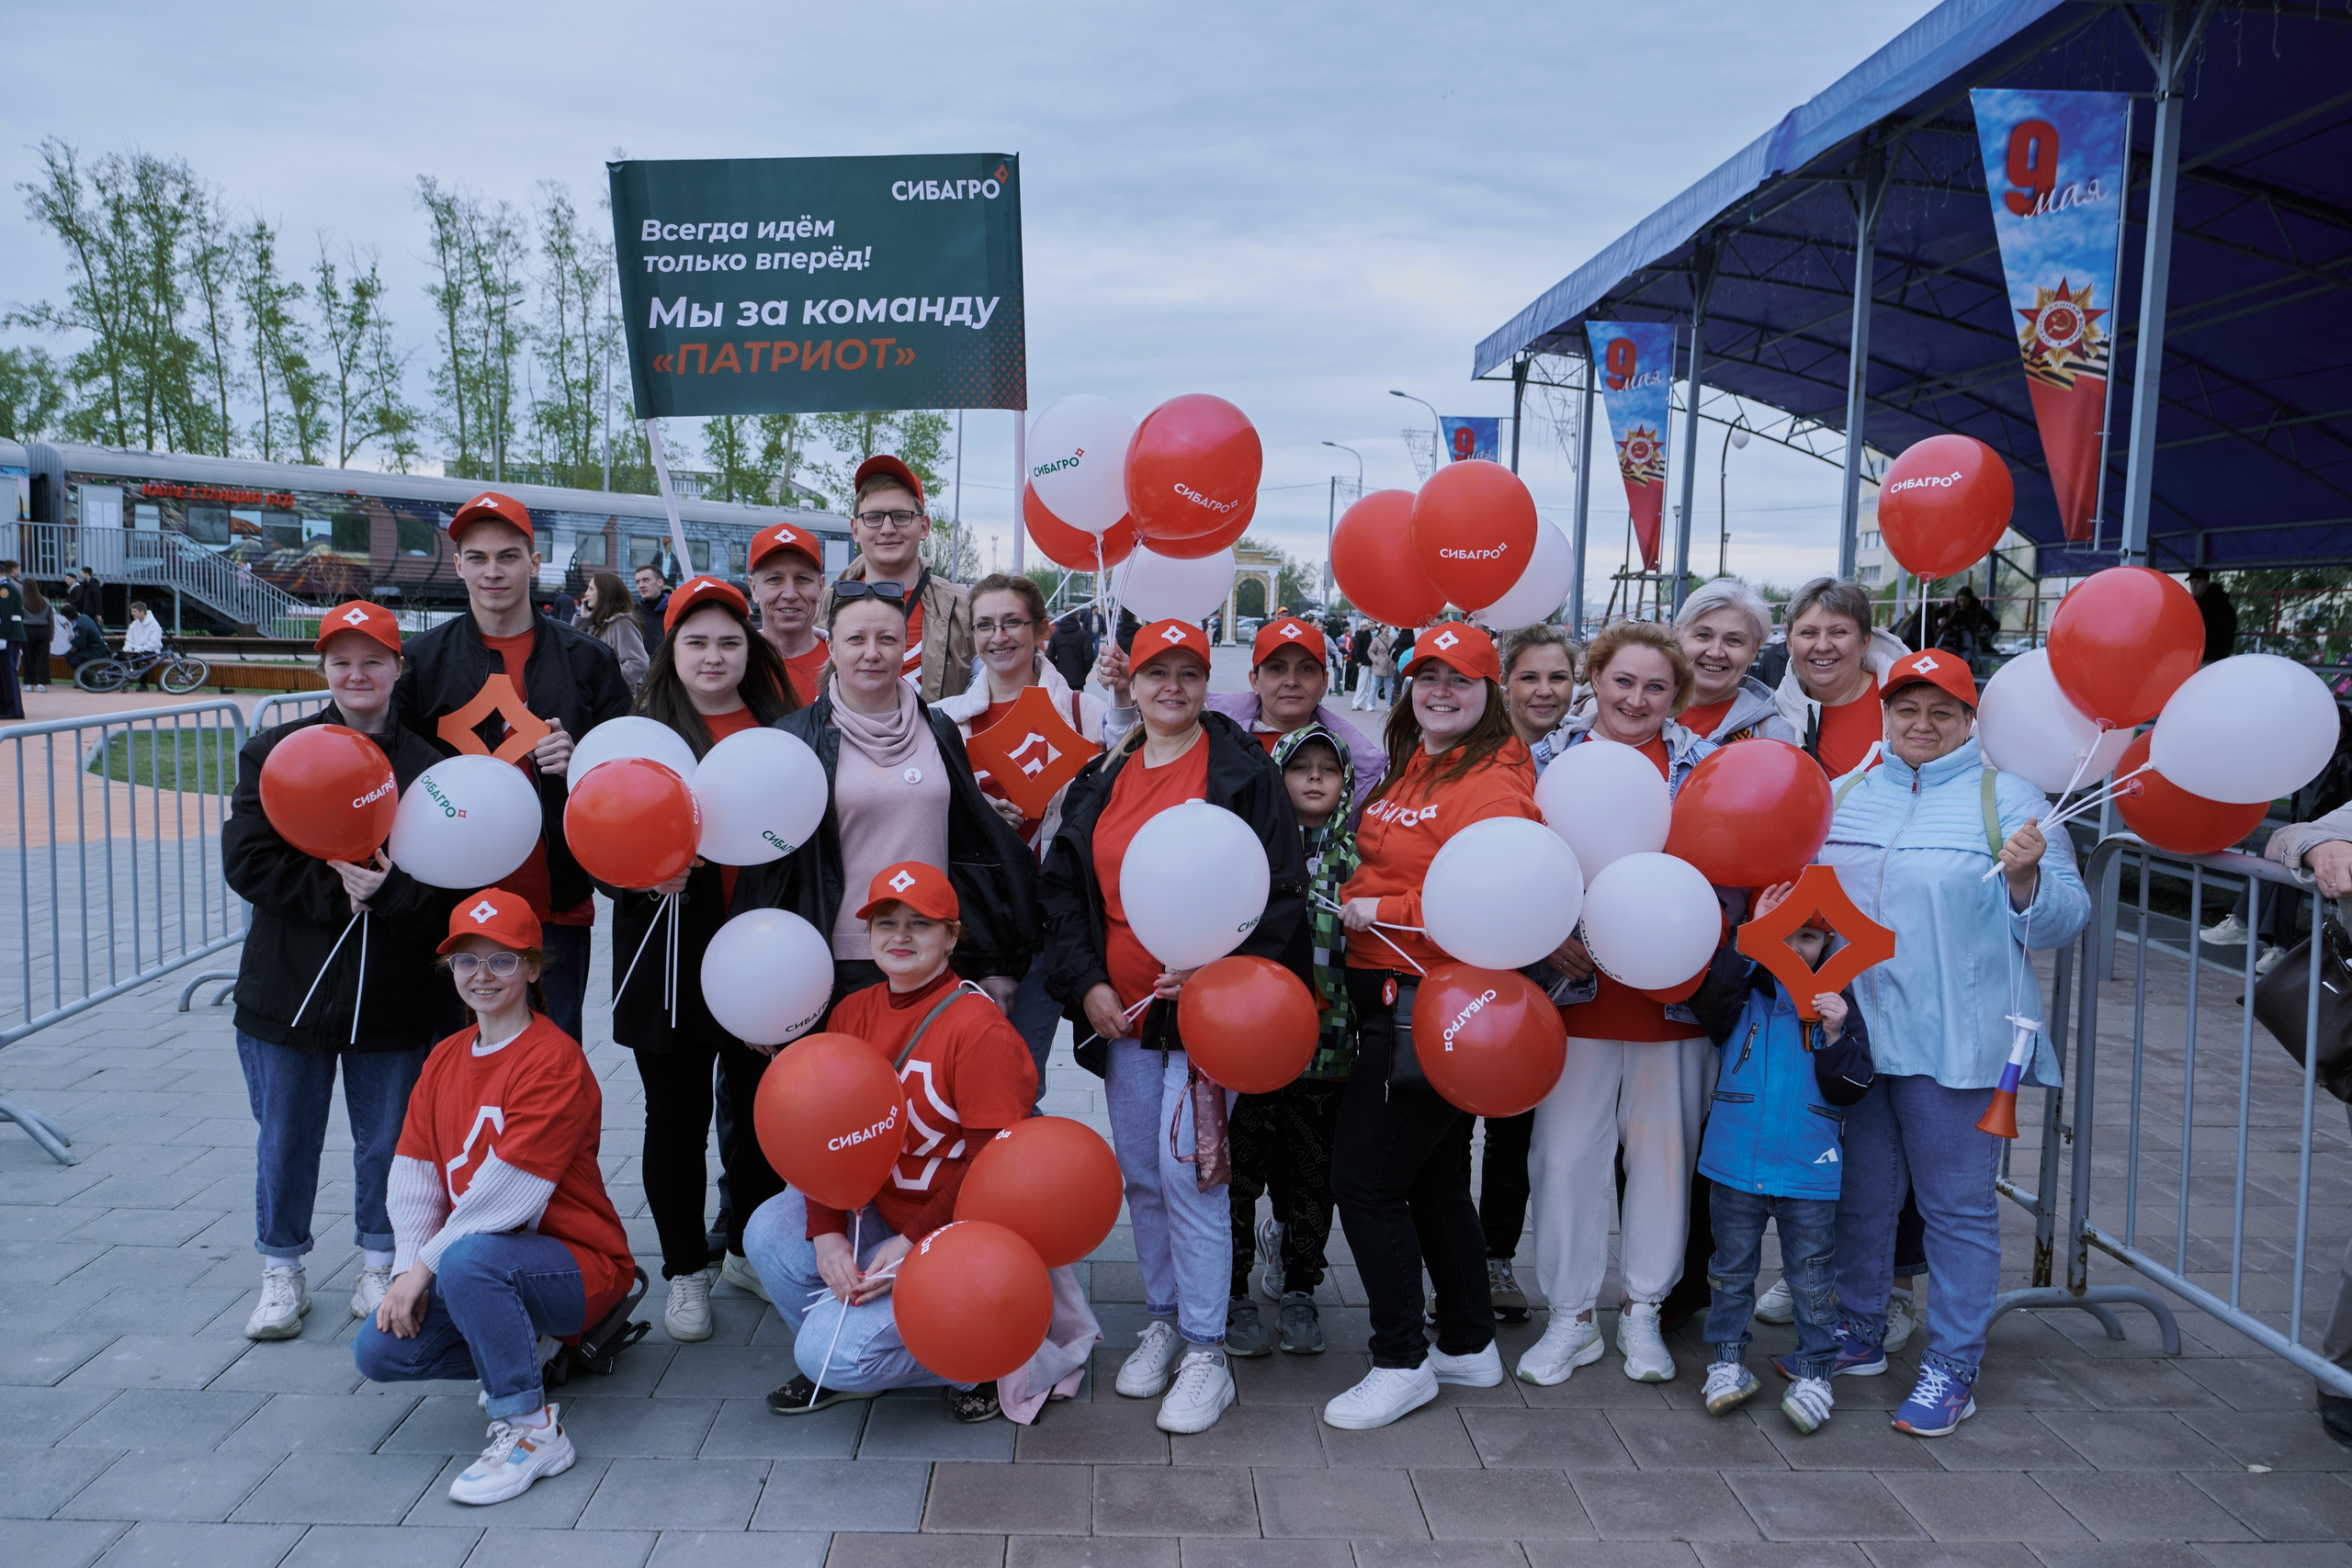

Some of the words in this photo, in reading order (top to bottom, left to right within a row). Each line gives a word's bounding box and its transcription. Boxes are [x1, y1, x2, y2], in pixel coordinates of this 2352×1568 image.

[2006, 119, 2060, 218] 9
[891, 178, 1001, 201] СИБАГРО
[2023, 178, 2109, 220] мая
[641, 219, 748, 243] Всегда
[757, 214, 835, 242] идём
[643, 252, 747, 273] только
[755, 245, 872, 274] вперёд!
[648, 296, 724, 329] Мы
[736, 300, 788, 327] за
[802, 296, 1001, 330] команду
[652, 337, 916, 376] «ПАТРИОТ»
[1606, 338, 1636, 392] 9
[1617, 370, 1665, 393] мая
[1454, 427, 1475, 461] 9
[1034, 457, 1080, 478] СИБАГРО
[141, 483, 187, 500] КАФЕ
[1173, 482, 1230, 513] СИБАГРО
[1890, 477, 1953, 494] СИБАГРО
[1439, 547, 1501, 559] СИБАГРО
[353, 779, 394, 808] СИБАГРО
[421, 774, 457, 818] СИБАГРО
[1580, 919, 1614, 977] СИБАГРО
[1443, 989, 1497, 1041] СИБАГРО
[828, 1116, 895, 1151] СИБАГРО
